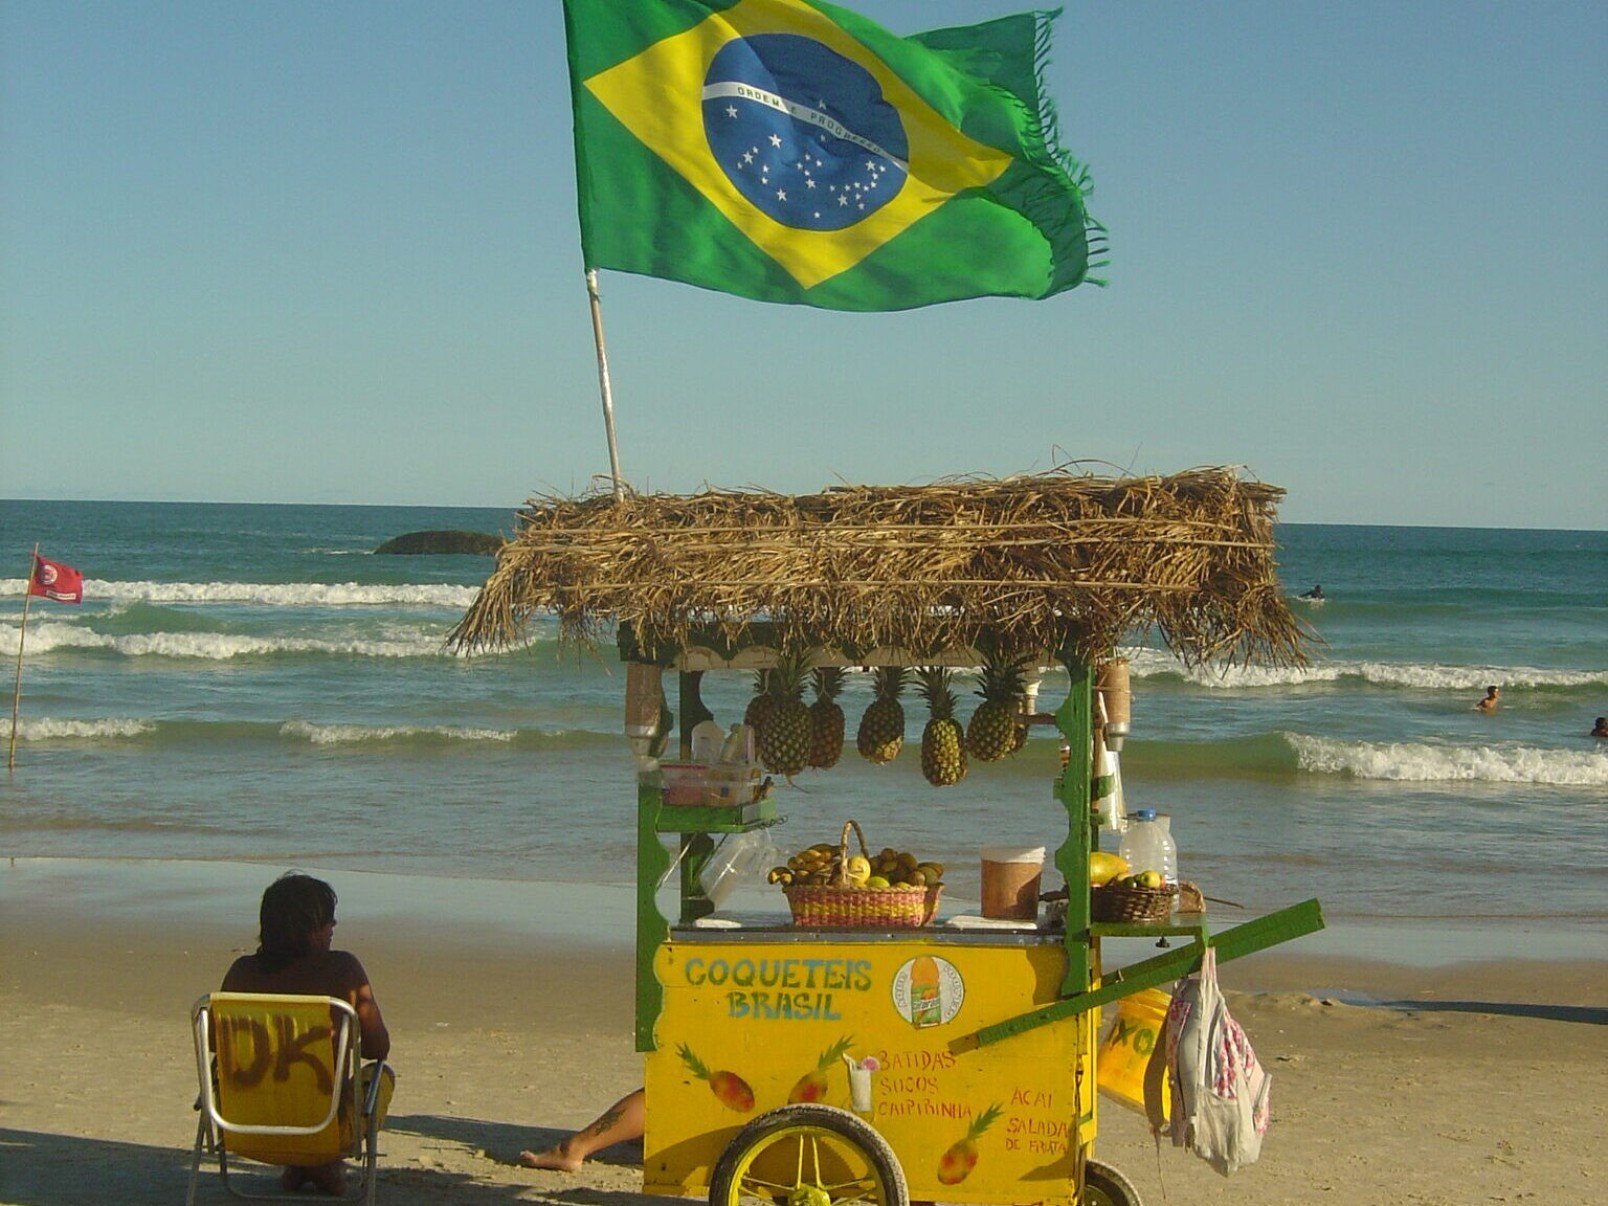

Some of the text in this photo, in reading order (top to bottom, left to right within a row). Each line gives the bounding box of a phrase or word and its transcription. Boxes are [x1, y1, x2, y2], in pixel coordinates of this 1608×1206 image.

[736, 85, 780, 107] ORDEM
[685, 957, 872, 992] COQUETEIS
[726, 991, 842, 1021] BRASIL
[221, 1013, 335, 1097] DK
[879, 1050, 956, 1071] BATIDAS
[880, 1076, 939, 1096] SUCOS
[1006, 1117, 1069, 1139] SALADA
[1005, 1137, 1021, 1151] DE
